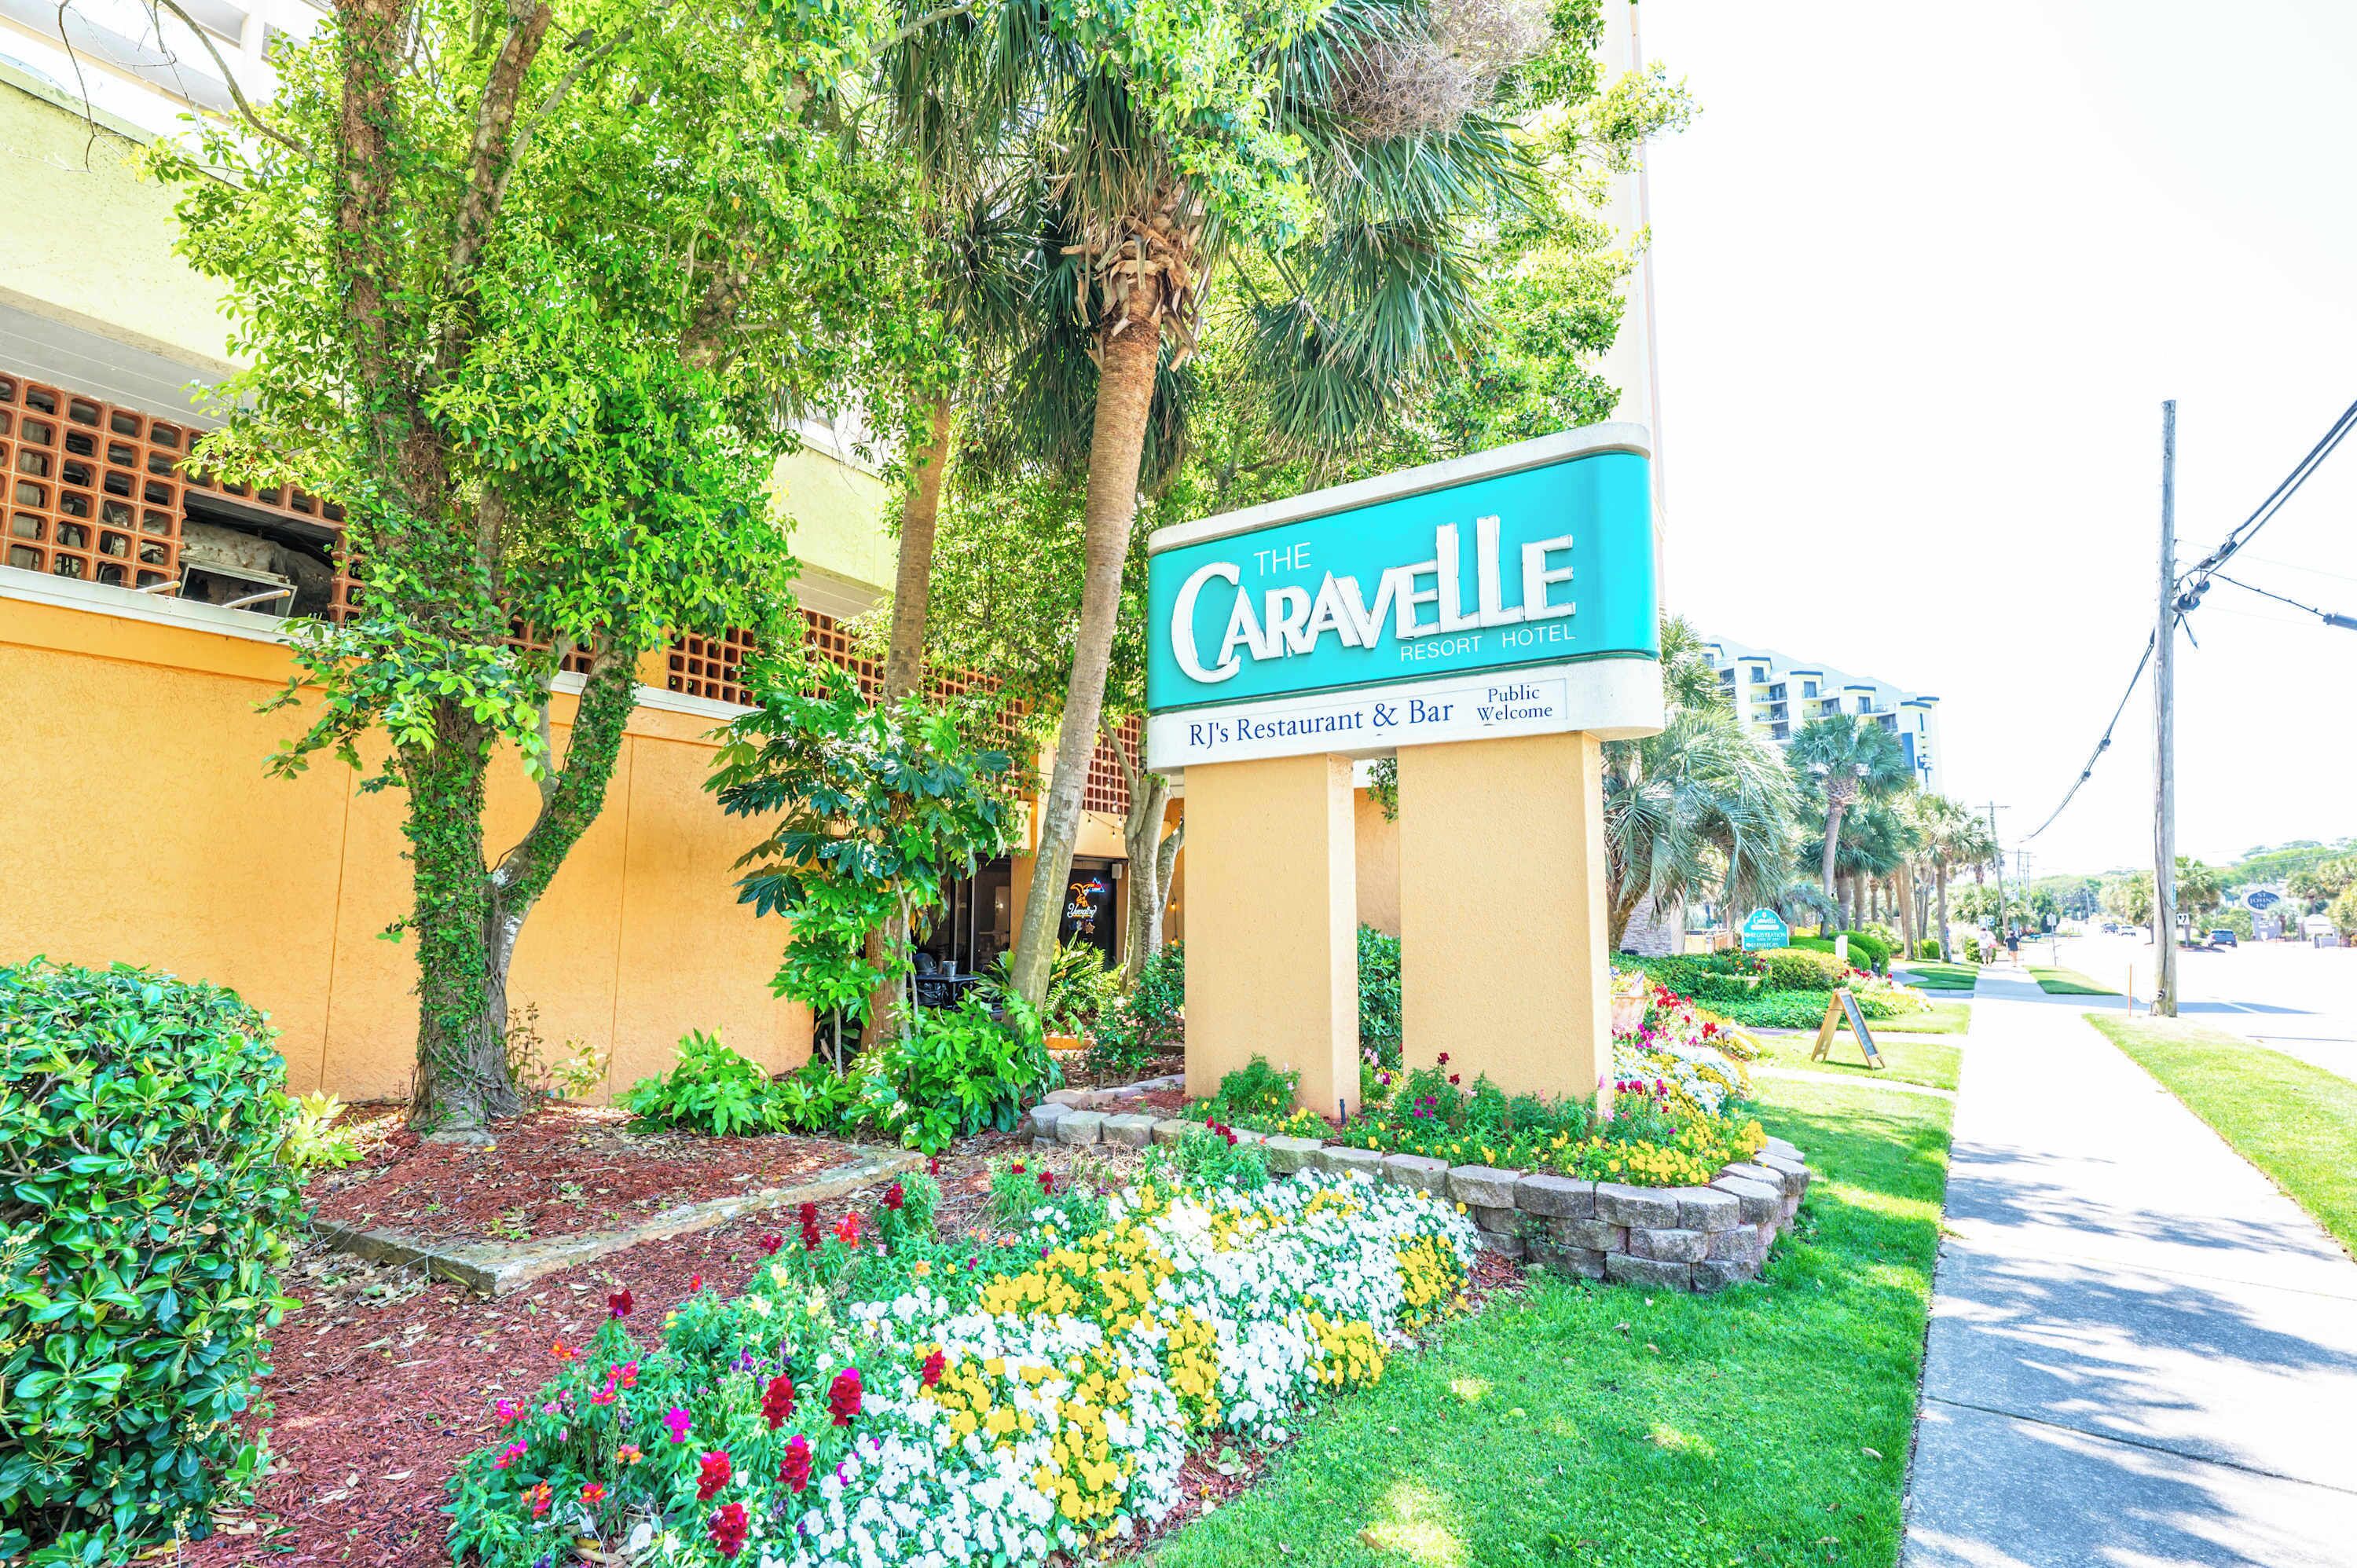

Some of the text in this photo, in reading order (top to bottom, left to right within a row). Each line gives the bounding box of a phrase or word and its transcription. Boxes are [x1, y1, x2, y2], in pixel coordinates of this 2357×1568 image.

[1253, 542, 1311, 577] THE
[1171, 515, 1576, 683] CARAVELLE
[1401, 624, 1576, 662] RESORT HOTEL
[1488, 684, 1541, 703] Public
[1189, 698, 1454, 749] RJ's Restaurant & Bar
[1477, 705, 1553, 722] Welcome
